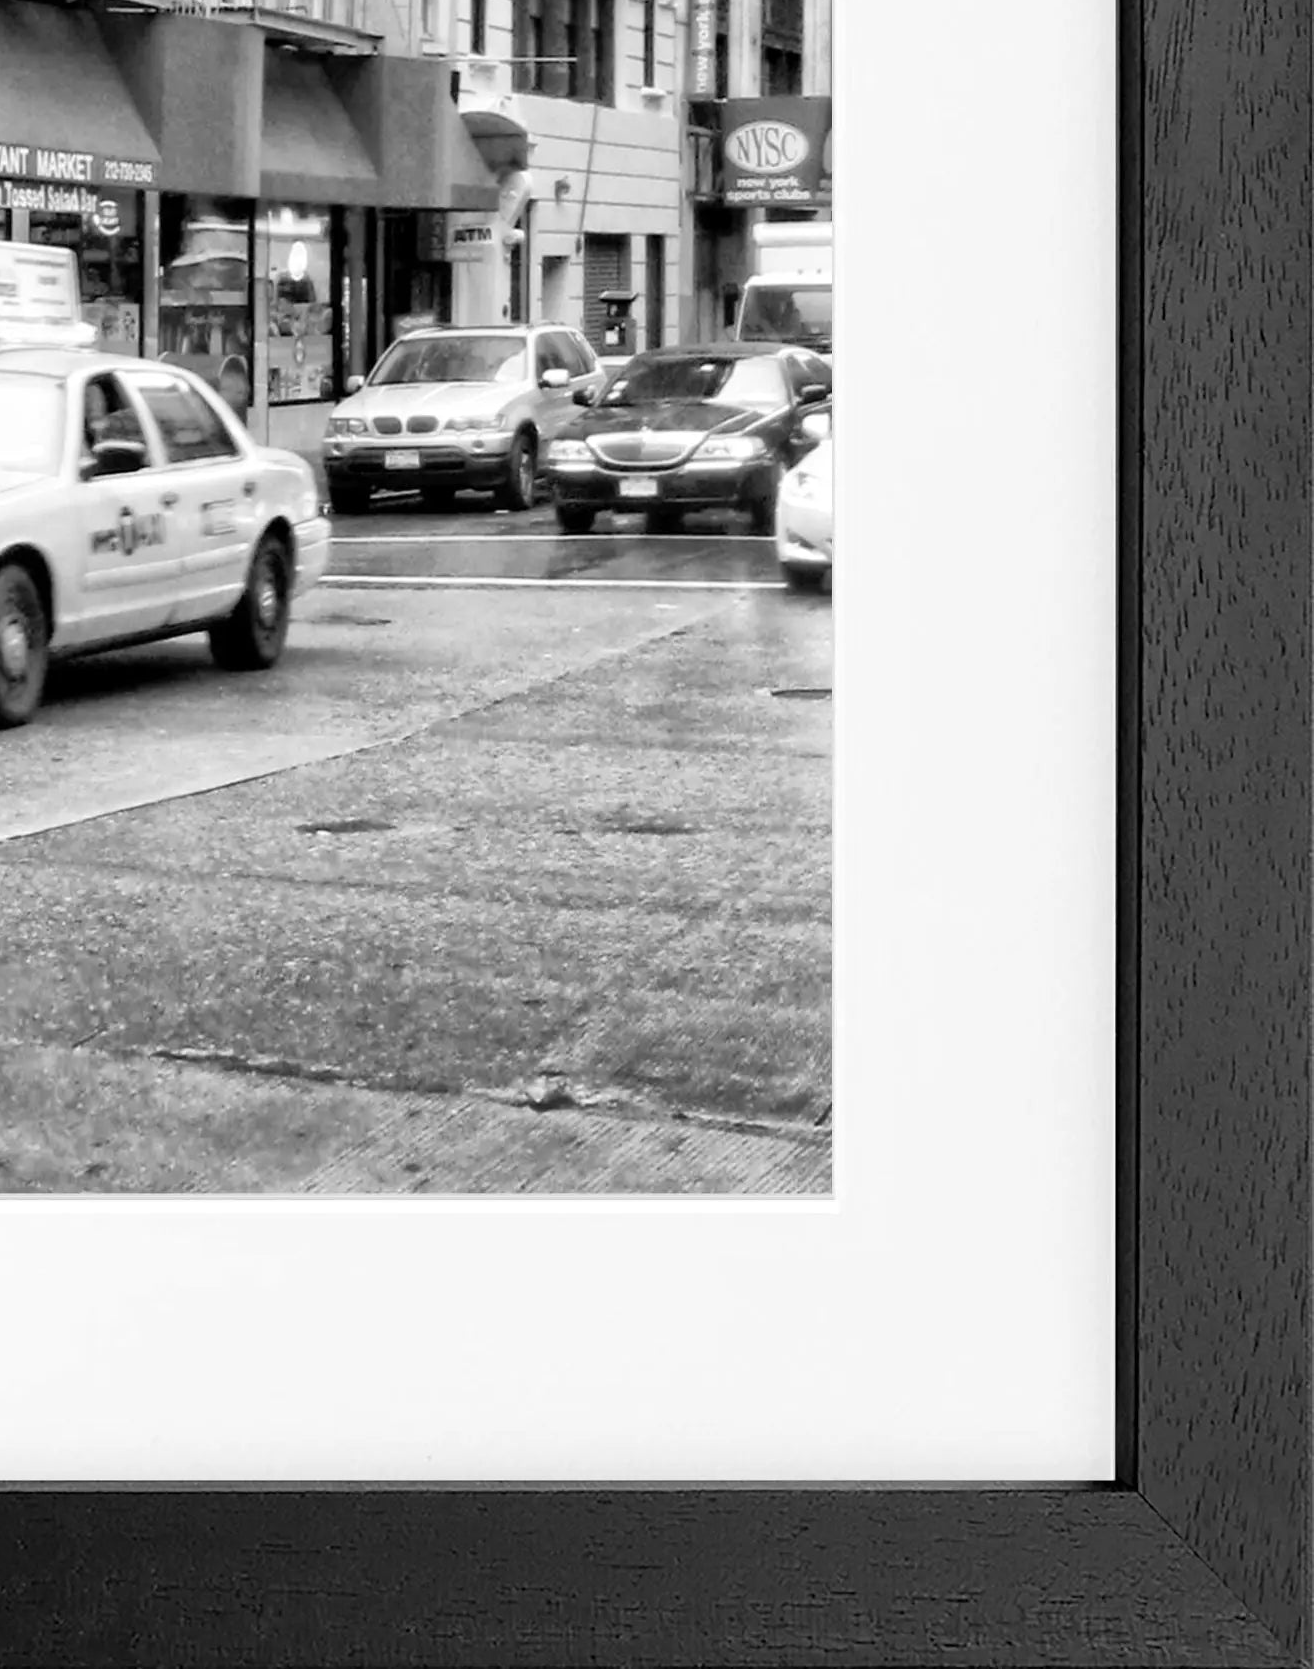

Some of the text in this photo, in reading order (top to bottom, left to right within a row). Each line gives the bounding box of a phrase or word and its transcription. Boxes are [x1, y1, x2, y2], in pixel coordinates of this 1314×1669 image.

[696, 10, 710, 50] york
[696, 55, 709, 93] new
[735, 127, 798, 168] NYSC
[36, 149, 94, 180] MARKET
[3, 181, 46, 210] Tossed
[726, 189, 771, 201] sports
[774, 188, 811, 200] clubs
[736, 176, 800, 190] new york
[453, 227, 492, 243] ATM
